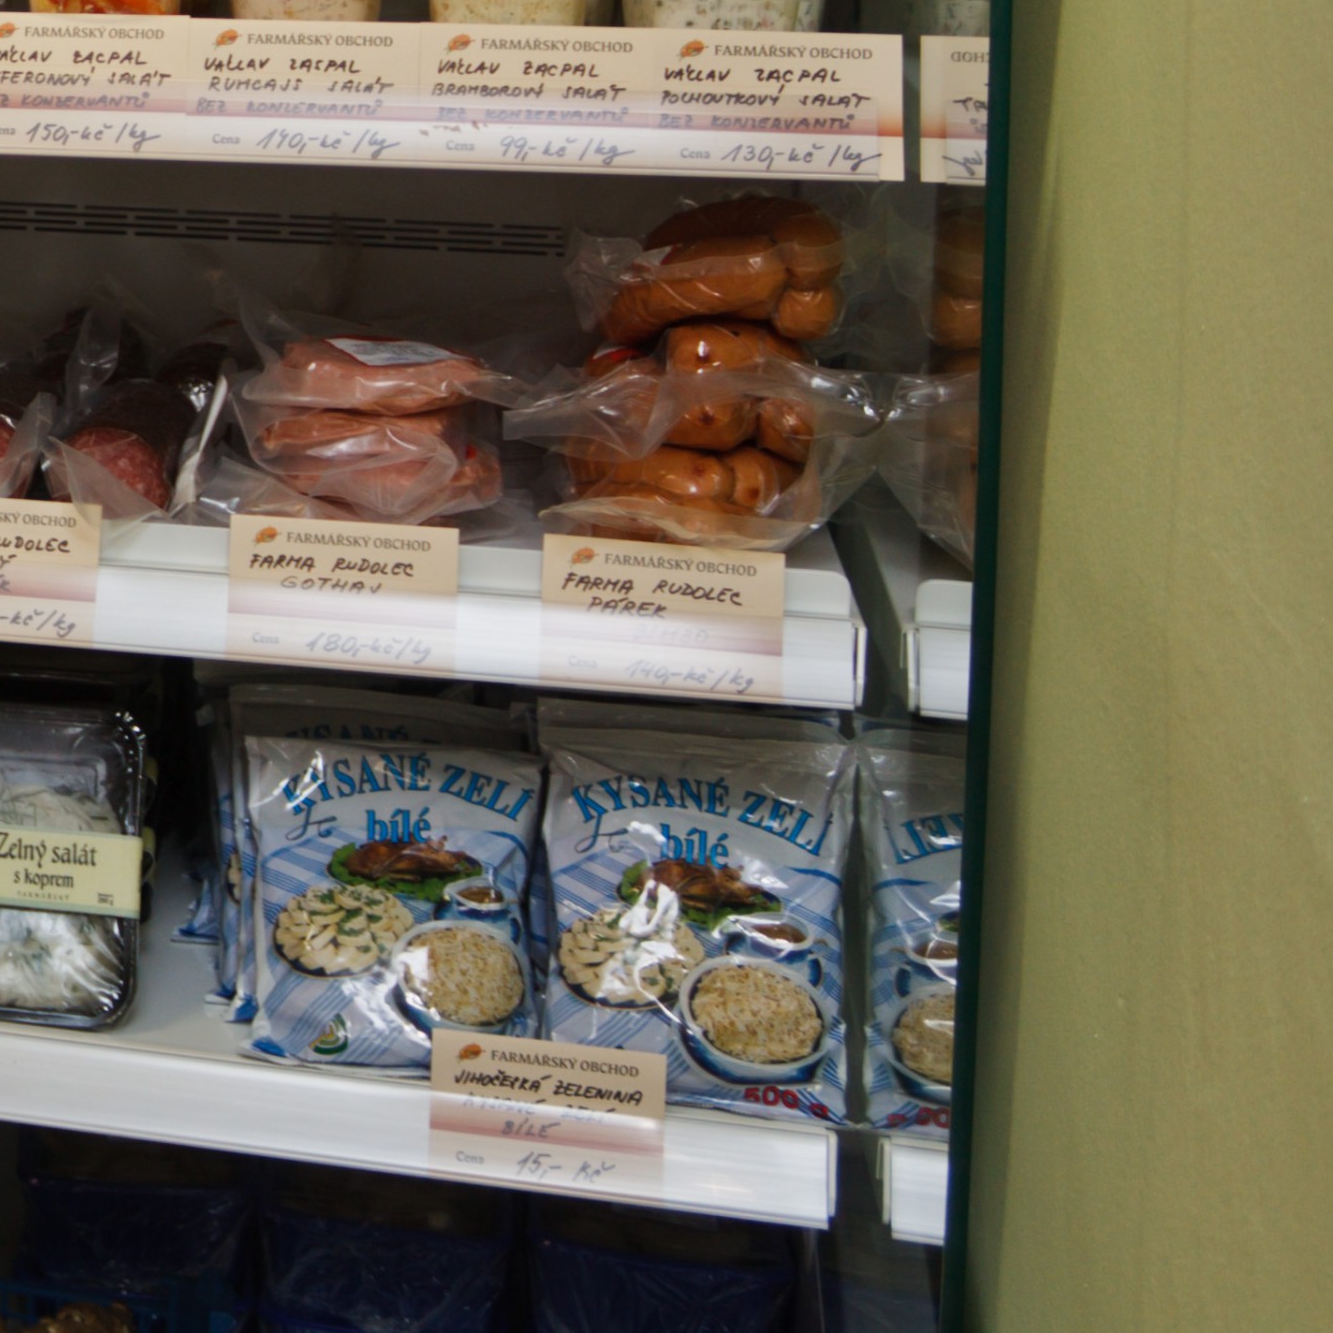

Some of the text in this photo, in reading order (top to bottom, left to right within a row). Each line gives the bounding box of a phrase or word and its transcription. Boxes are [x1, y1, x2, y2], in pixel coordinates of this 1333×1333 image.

[24, 26, 164, 40] FARMÁŘSKÝ OBCHOD
[247, 33, 393, 47] FARMÁŘSKÝ OBCHOD
[481, 38, 633, 53] FARMÁŘSKÝ OBCHOD
[714, 44, 873, 60] FARMÁŘSKÝ OBCHOD
[212, 133, 241, 145] Cena
[445, 140, 476, 152] Cena
[680, 148, 711, 160] Cena
[22, 513, 77, 529] OBCHOD
[286, 531, 431, 552] FARMÁŘSKÝ OBCHOD
[249, 553, 415, 578] FARMA RUDOLEC
[604, 552, 758, 577] FARMÁŘSKÝ OBCHOD
[280, 575, 383, 594] GOTHAJ
[561, 572, 744, 607] FARMA RUDOLEC
[586, 596, 669, 619] PÁREK
[251, 632, 280, 644] Cena
[439, 763, 535, 822] ZELÍ
[365, 806, 432, 844] bílé
[572, 774, 730, 824] KYSANÉ
[738, 790, 834, 856] ZELÍ
[51, 843, 98, 867] salát
[659, 822, 729, 869] bílé
[13, 868, 74, 890] s koprem
[491, 1049, 640, 1077] FARMÁŘSKÝ OBCHOD
[743, 1086, 800, 1109] 500
